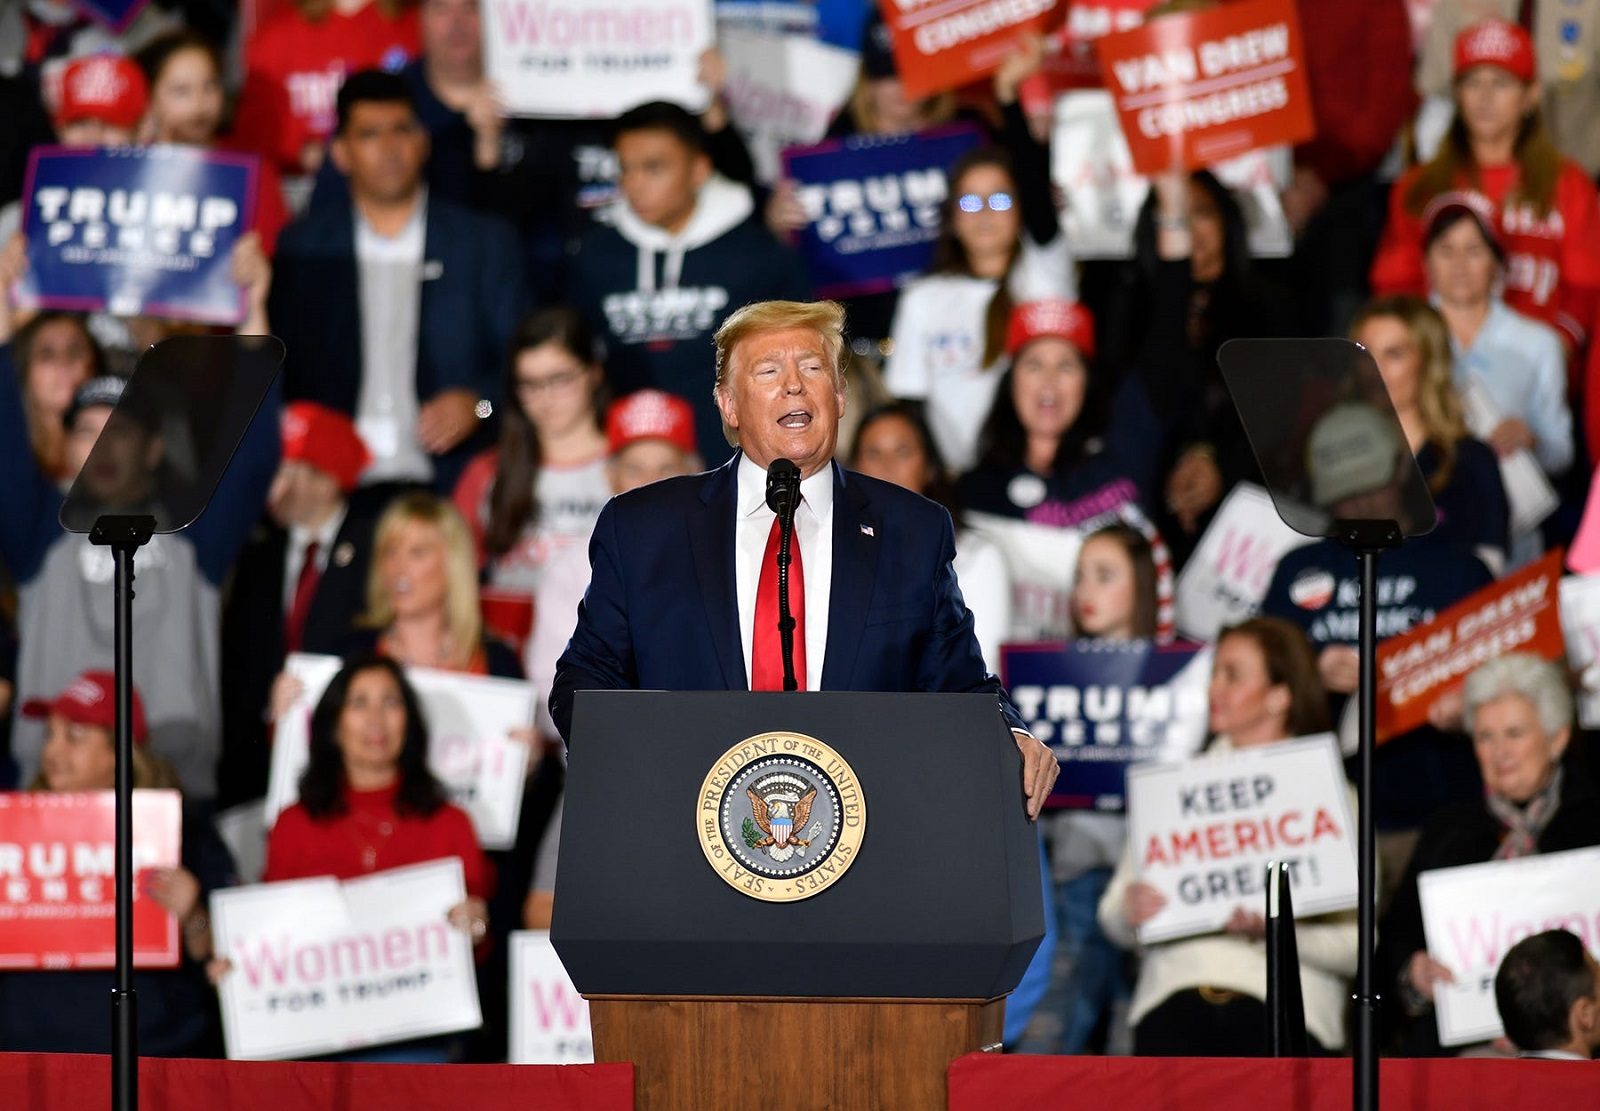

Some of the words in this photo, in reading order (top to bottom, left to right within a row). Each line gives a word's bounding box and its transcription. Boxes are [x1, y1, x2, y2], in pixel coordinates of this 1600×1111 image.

[1112, 47, 1198, 93] VAN
[1199, 23, 1289, 77] DREW
[1138, 78, 1289, 138] CONGRESS
[36, 187, 238, 231] TRUMP
[796, 168, 948, 221] TRUM
[1382, 627, 1452, 677] VAN
[1456, 574, 1548, 640] DREW
[1390, 616, 1536, 706] CONGRESS
[783, 740, 800, 751] OF
[802, 742, 824, 761] THE
[703, 738, 778, 811] PRESIDENT
[828, 760, 860, 828] UNITED
[1179, 774, 1275, 817] KEEP
[704, 817, 719, 842] THE
[710, 843, 724, 859] OF
[1143, 806, 1343, 870] AMERICA
[723, 860, 765, 893] SEAL
[796, 843, 852, 893] STATES
[233, 921, 450, 988] Women
[267, 989, 326, 1013] FOR
[339, 969, 430, 1005] TRUMP
